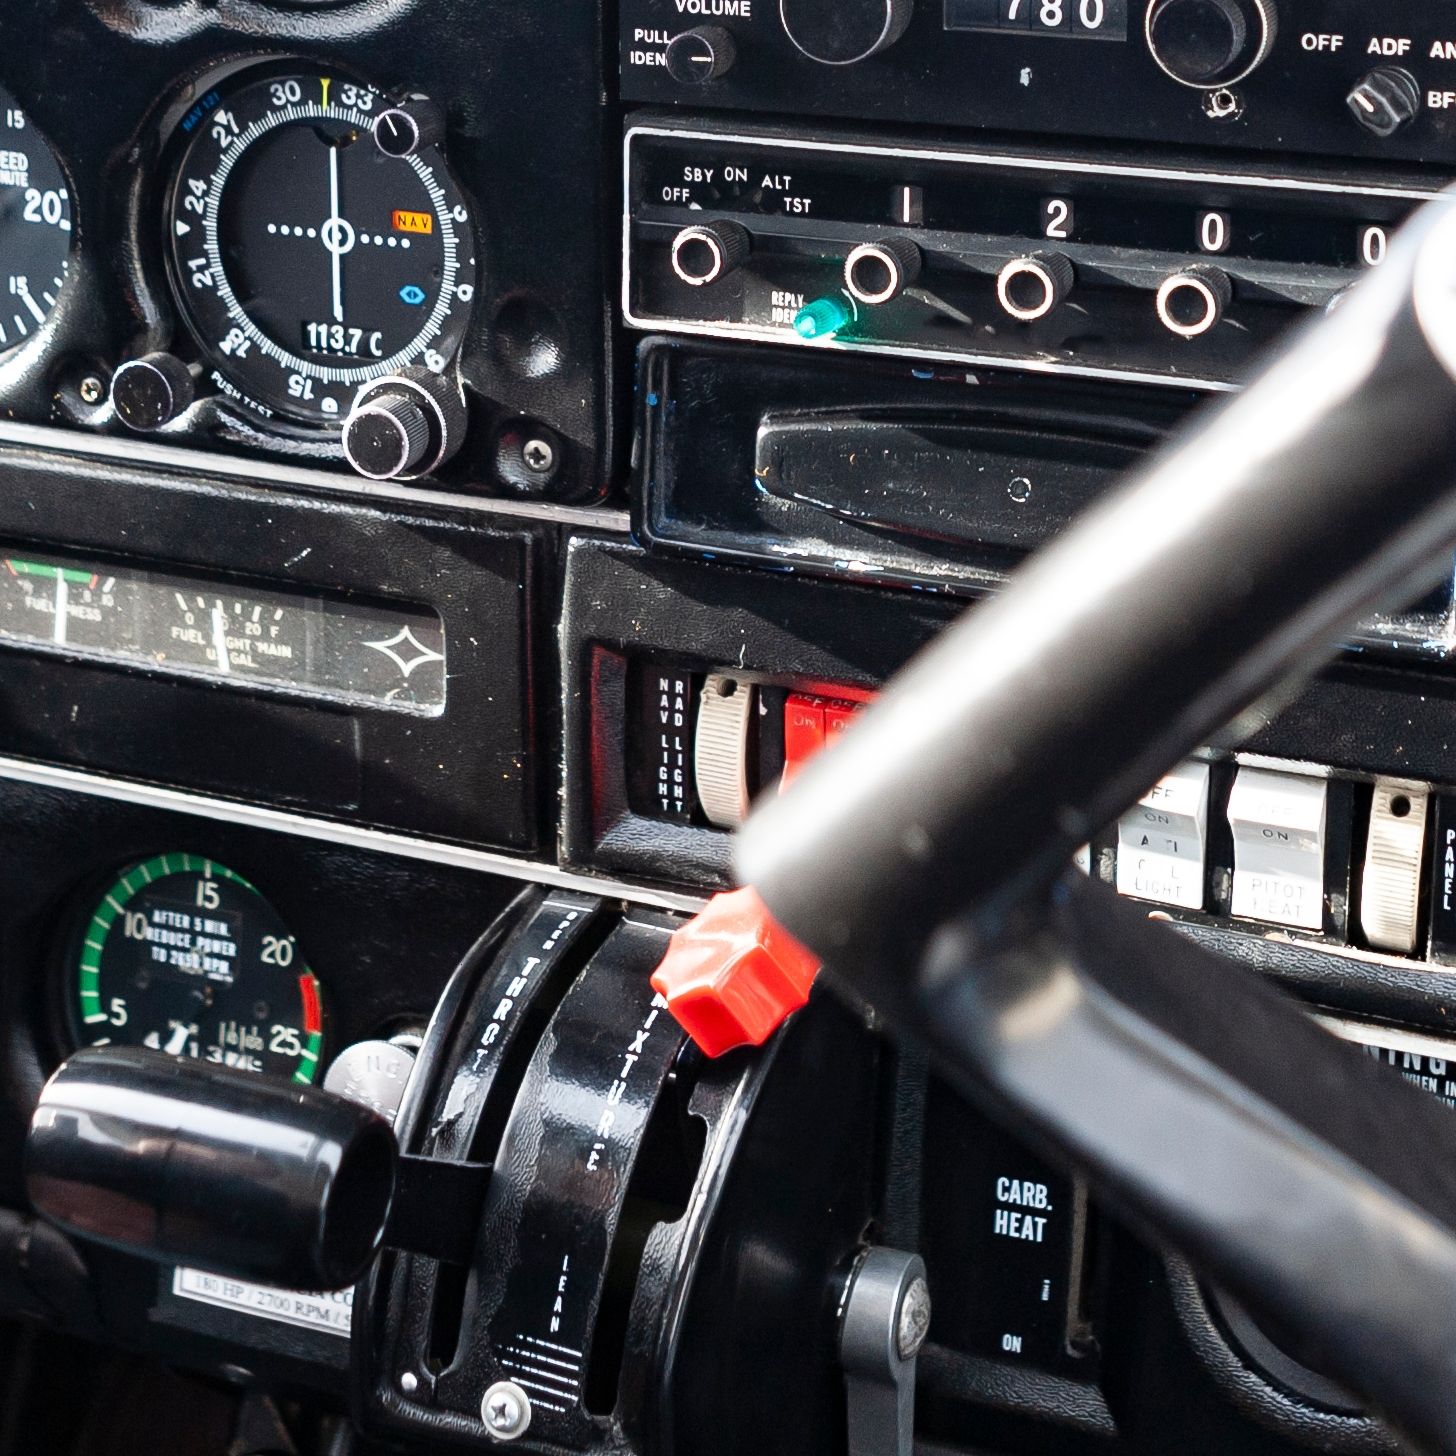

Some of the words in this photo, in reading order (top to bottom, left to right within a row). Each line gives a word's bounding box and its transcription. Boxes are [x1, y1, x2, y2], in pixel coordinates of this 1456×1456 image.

[634, 28, 671, 44] PULL
[1301, 33, 1343, 53] OFF
[1367, 38, 1411, 57] ADF
[270, 80, 302, 106] 30
[341, 83, 373, 111] 33
[6, 108, 26, 129] 15
[684, 166, 714, 183] SBY
[724, 166, 748, 183] ON
[761, 174, 792, 191] ALT
[23, 187, 62, 224] 20
[185, 177, 207, 214] 24
[662, 187, 691, 203] OFF
[783, 197, 812, 213] TST
[397, 213, 430, 230] NAV
[1047, 199, 1068, 238] 2
[1201, 212, 1225, 251] 0
[1362, 227, 1387, 266] 0
[9, 275, 29, 296] 15
[192, 257, 213, 289] 21
[771, 290, 804, 309] REPLY
[210, 370, 242, 400] PUSH
[287, 374, 315, 401] 15
[171, 626, 206, 645] FUEL
[255, 641, 293, 659] MAIN
[244, 621, 262, 637] 20
[270, 624, 280, 639] F
[659, 677, 670, 725] NAV
[674, 679, 685, 728] RAD
[658, 733, 670, 813] LIGHT
[674, 735, 685, 814] LIGHT
[1144, 811, 1170, 826] ON
[1262, 828, 1290, 842] ON
[1443, 828, 1456, 911] PANEL
[196, 880, 220, 909] 15
[1251, 877, 1306, 897] PITOT
[124, 912, 148, 940] 10
[152, 909, 191, 930] AFTER
[145, 926, 191, 948] REDUCE
[196, 935, 237, 957] POWER
[260, 935, 293, 967] 20
[110, 997, 127, 1026] 5
[269, 1024, 301, 1056] 25
[996, 1176, 1053, 1212] CARB.
[994, 1209, 1047, 1242] HEAT
[223, 1281, 245, 1298] HP
[257, 1290, 291, 1312] 2700
[295, 1300, 330, 1323] RPM
[549, 1253, 570, 1333] LEAN
[1002, 1334, 1022, 1354] ON
